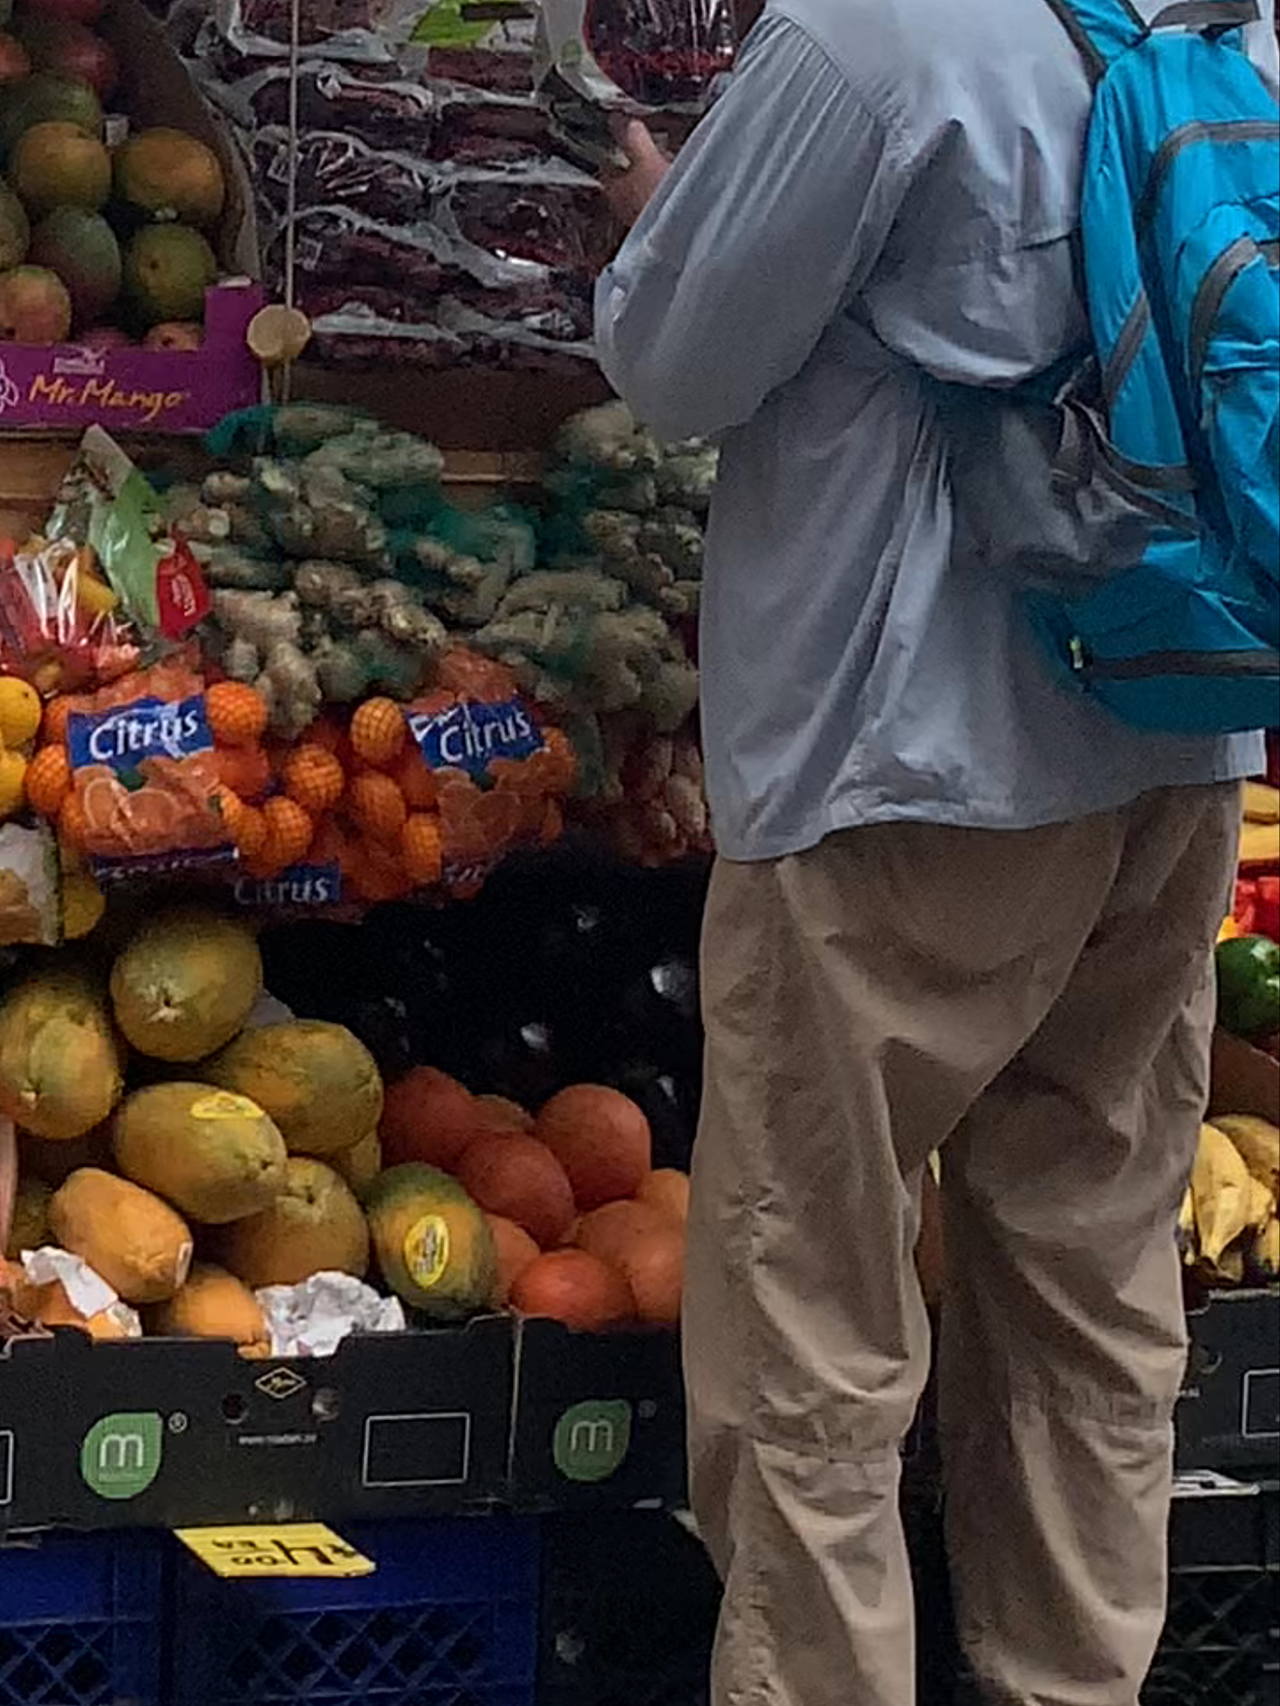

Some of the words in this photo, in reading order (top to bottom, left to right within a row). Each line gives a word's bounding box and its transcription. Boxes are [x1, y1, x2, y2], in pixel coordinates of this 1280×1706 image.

[80, 378, 184, 423] Mango
[89, 707, 198, 760] Citrus
[439, 710, 534, 763] Citrus
